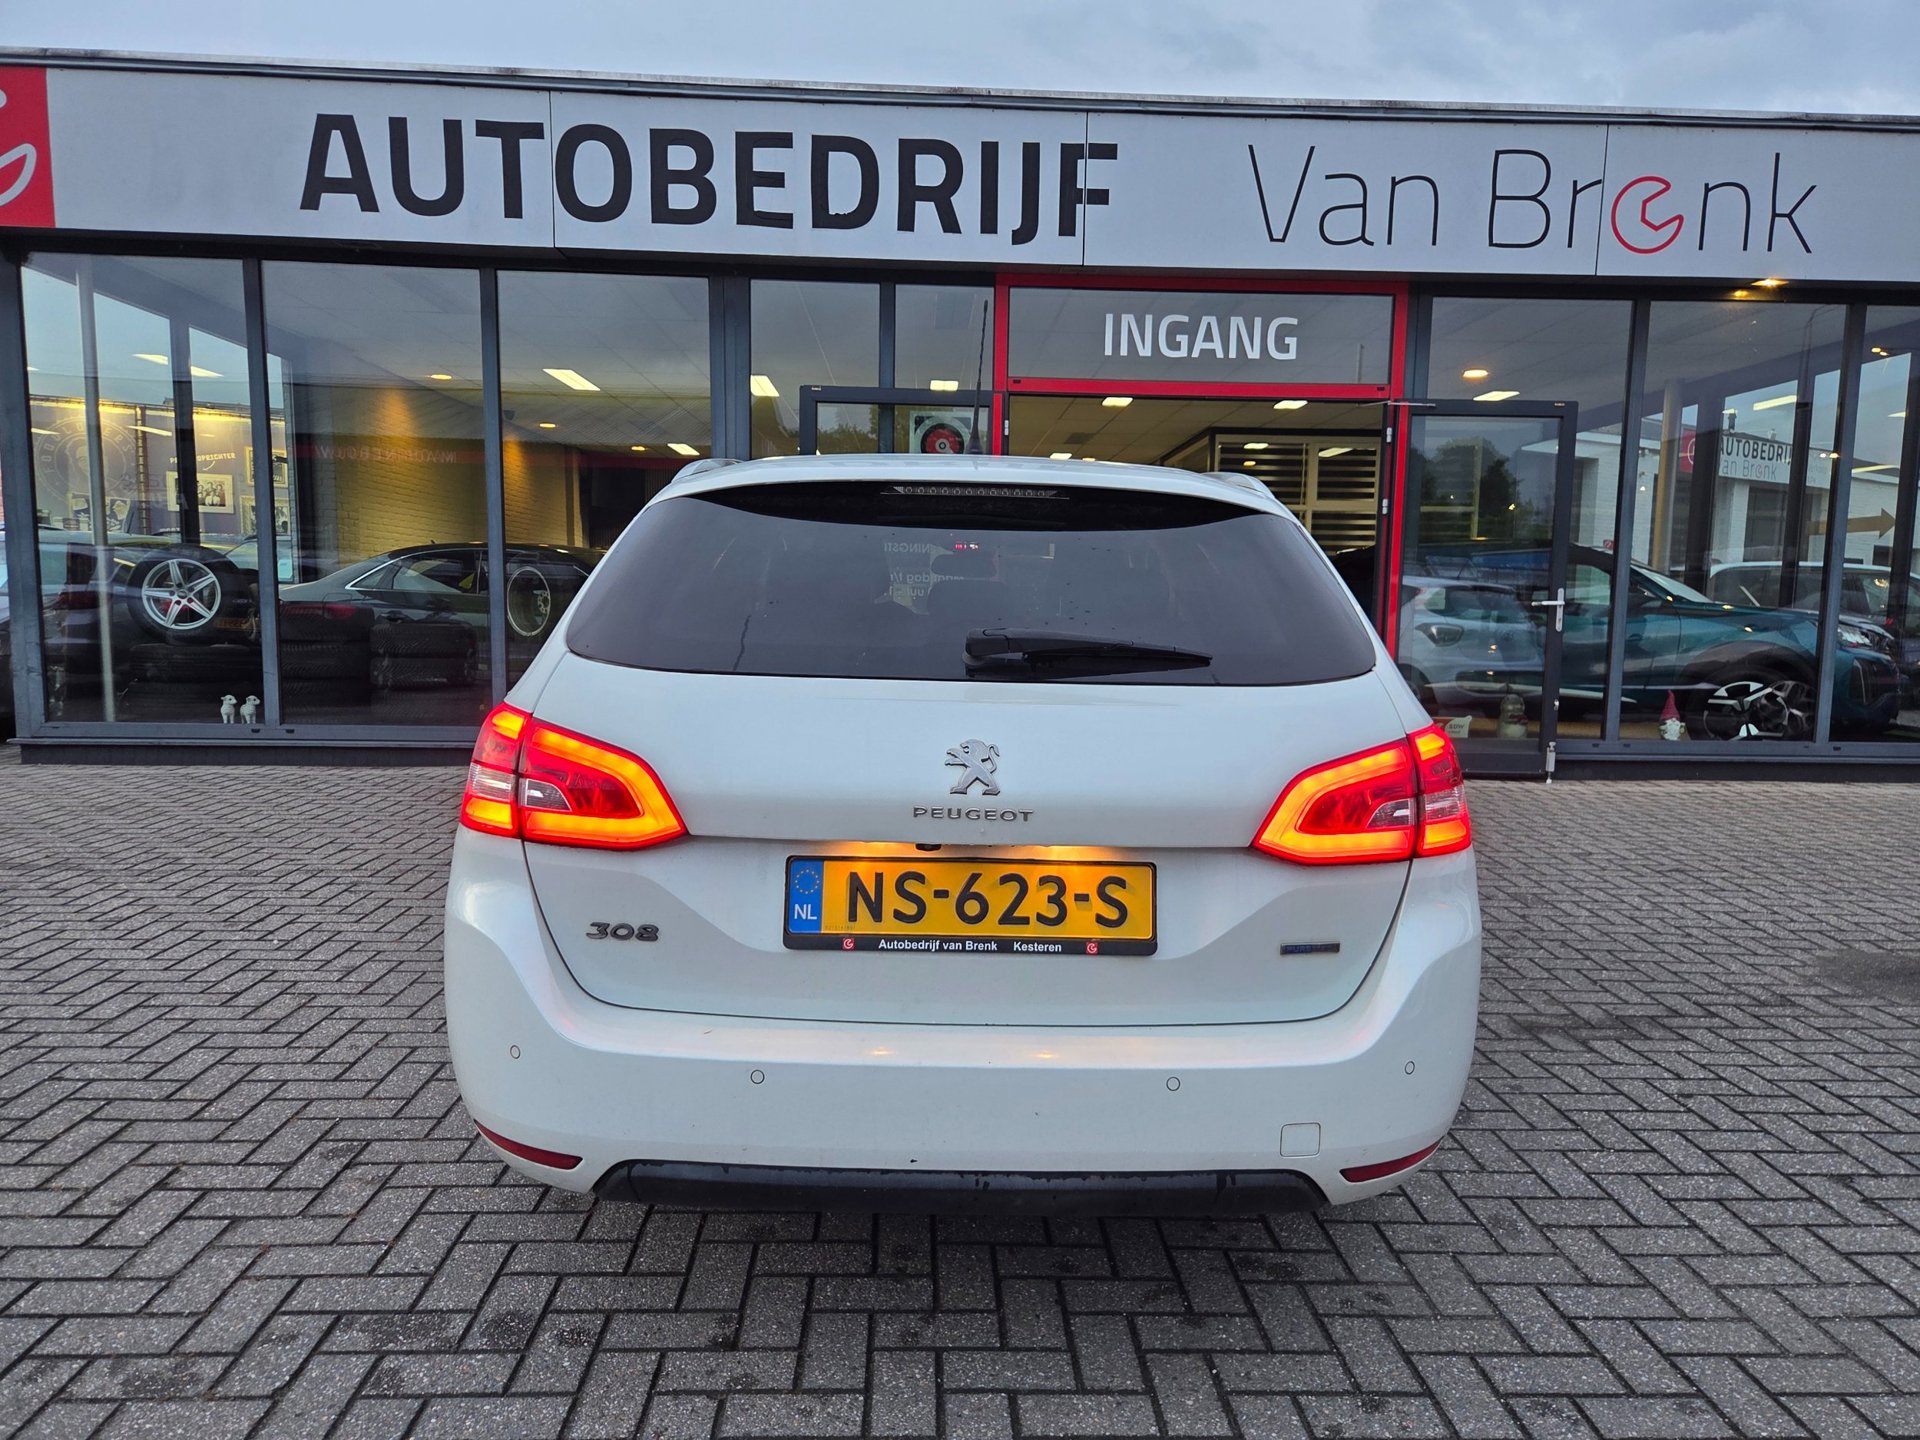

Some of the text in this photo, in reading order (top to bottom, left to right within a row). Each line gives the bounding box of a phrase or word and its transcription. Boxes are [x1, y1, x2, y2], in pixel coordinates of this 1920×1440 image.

[299, 113, 1118, 246] AUTOBEDRIJF
[1247, 143, 1440, 248] Van
[1104, 313, 1299, 360] INGANG
[913, 806, 1035, 822] PEUGEOT
[794, 871, 1128, 929] NL NS-623-S
[586, 922, 659, 942] 308
[878, 939, 1062, 952] Autobedrijf van Brenk Kesteren
